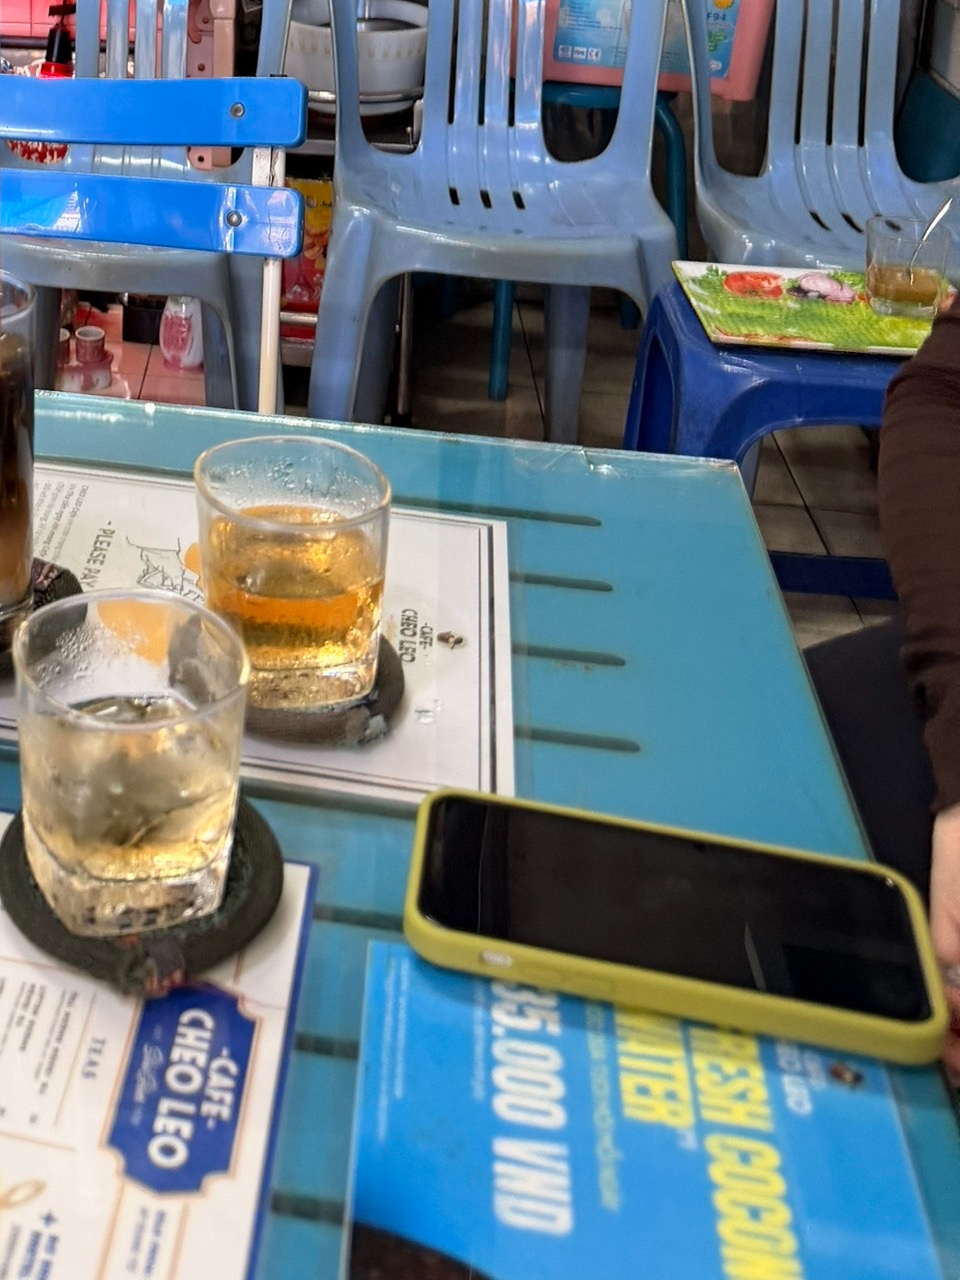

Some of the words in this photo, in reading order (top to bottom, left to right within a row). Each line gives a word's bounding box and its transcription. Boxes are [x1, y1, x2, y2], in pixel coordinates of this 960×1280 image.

[87, 527, 115, 566] PLEASE
[398, 638, 416, 663] LEO
[401, 607, 418, 638] CHEO
[81, 1036, 106, 1081] TEAS
[169, 1007, 216, 1099] CHEO
[690, 1023, 777, 1132] RESH
[146, 1097, 196, 1172] LEO
[492, 1135, 574, 1237] VND
